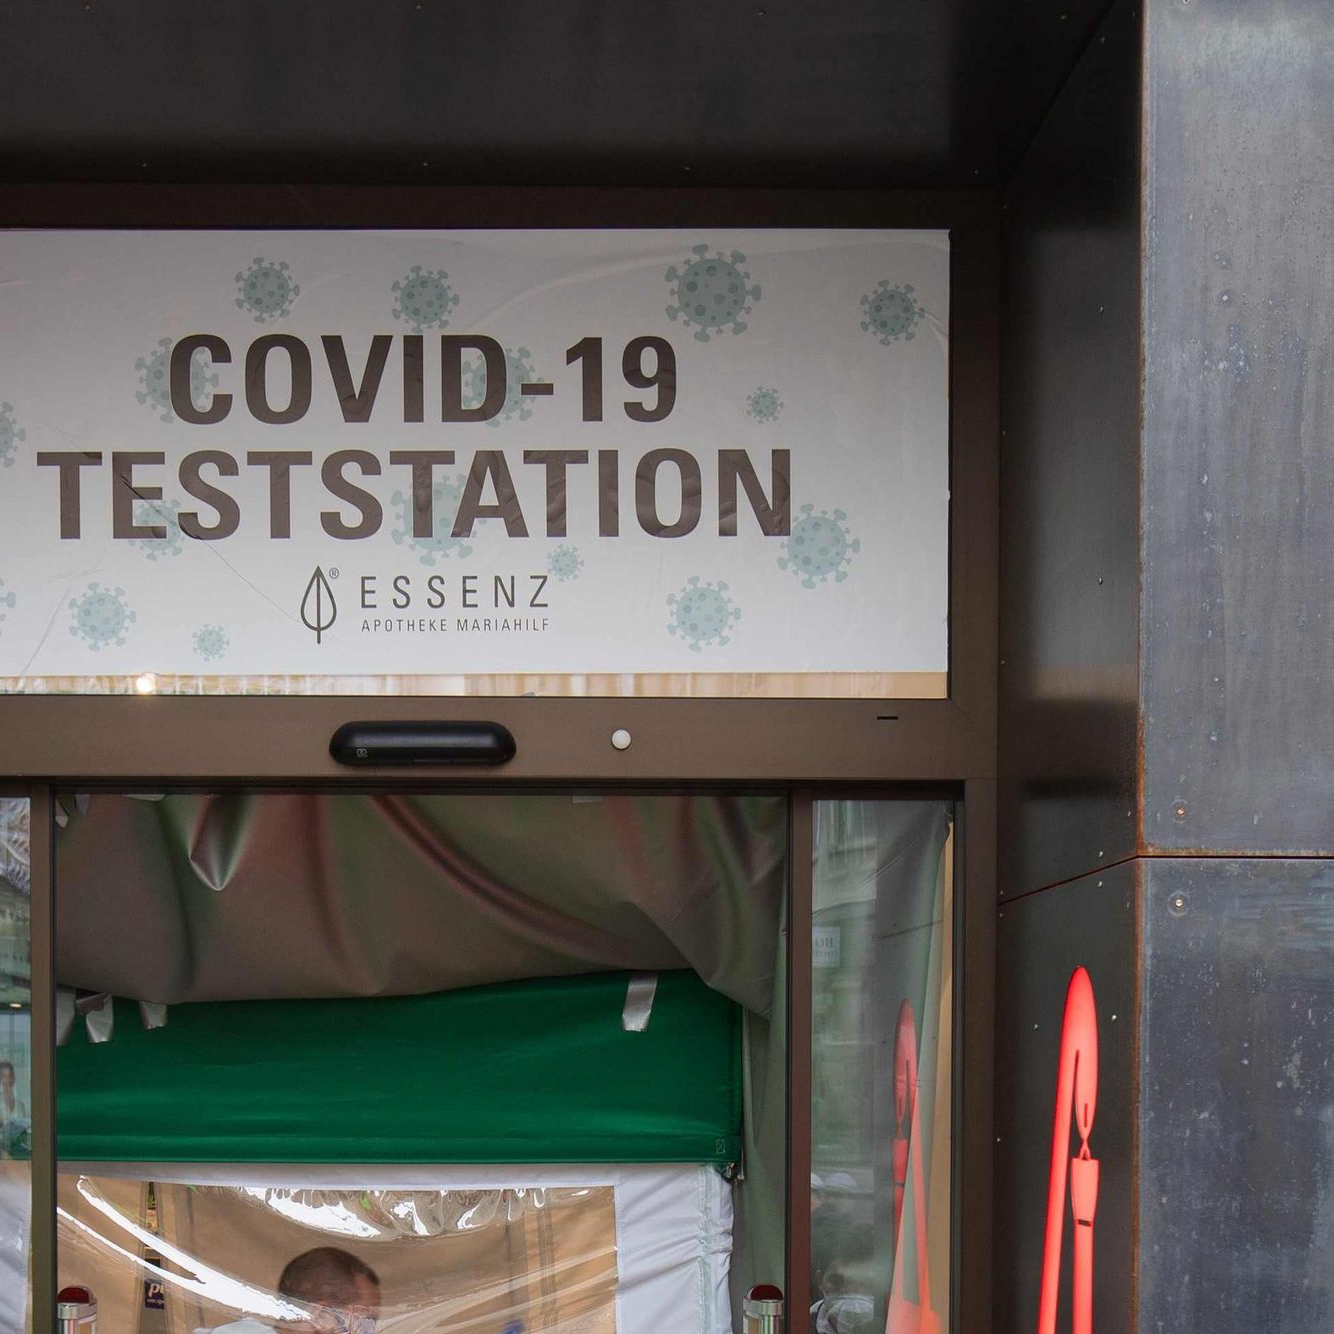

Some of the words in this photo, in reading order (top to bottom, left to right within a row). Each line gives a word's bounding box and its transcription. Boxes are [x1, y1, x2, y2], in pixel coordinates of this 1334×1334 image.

[167, 334, 677, 426] COVID-19
[37, 447, 792, 541] TESTSTATION
[361, 575, 548, 609] ESSENZ
[362, 619, 447, 632] APOTHEKE
[457, 618, 549, 631] MARIAHILF
